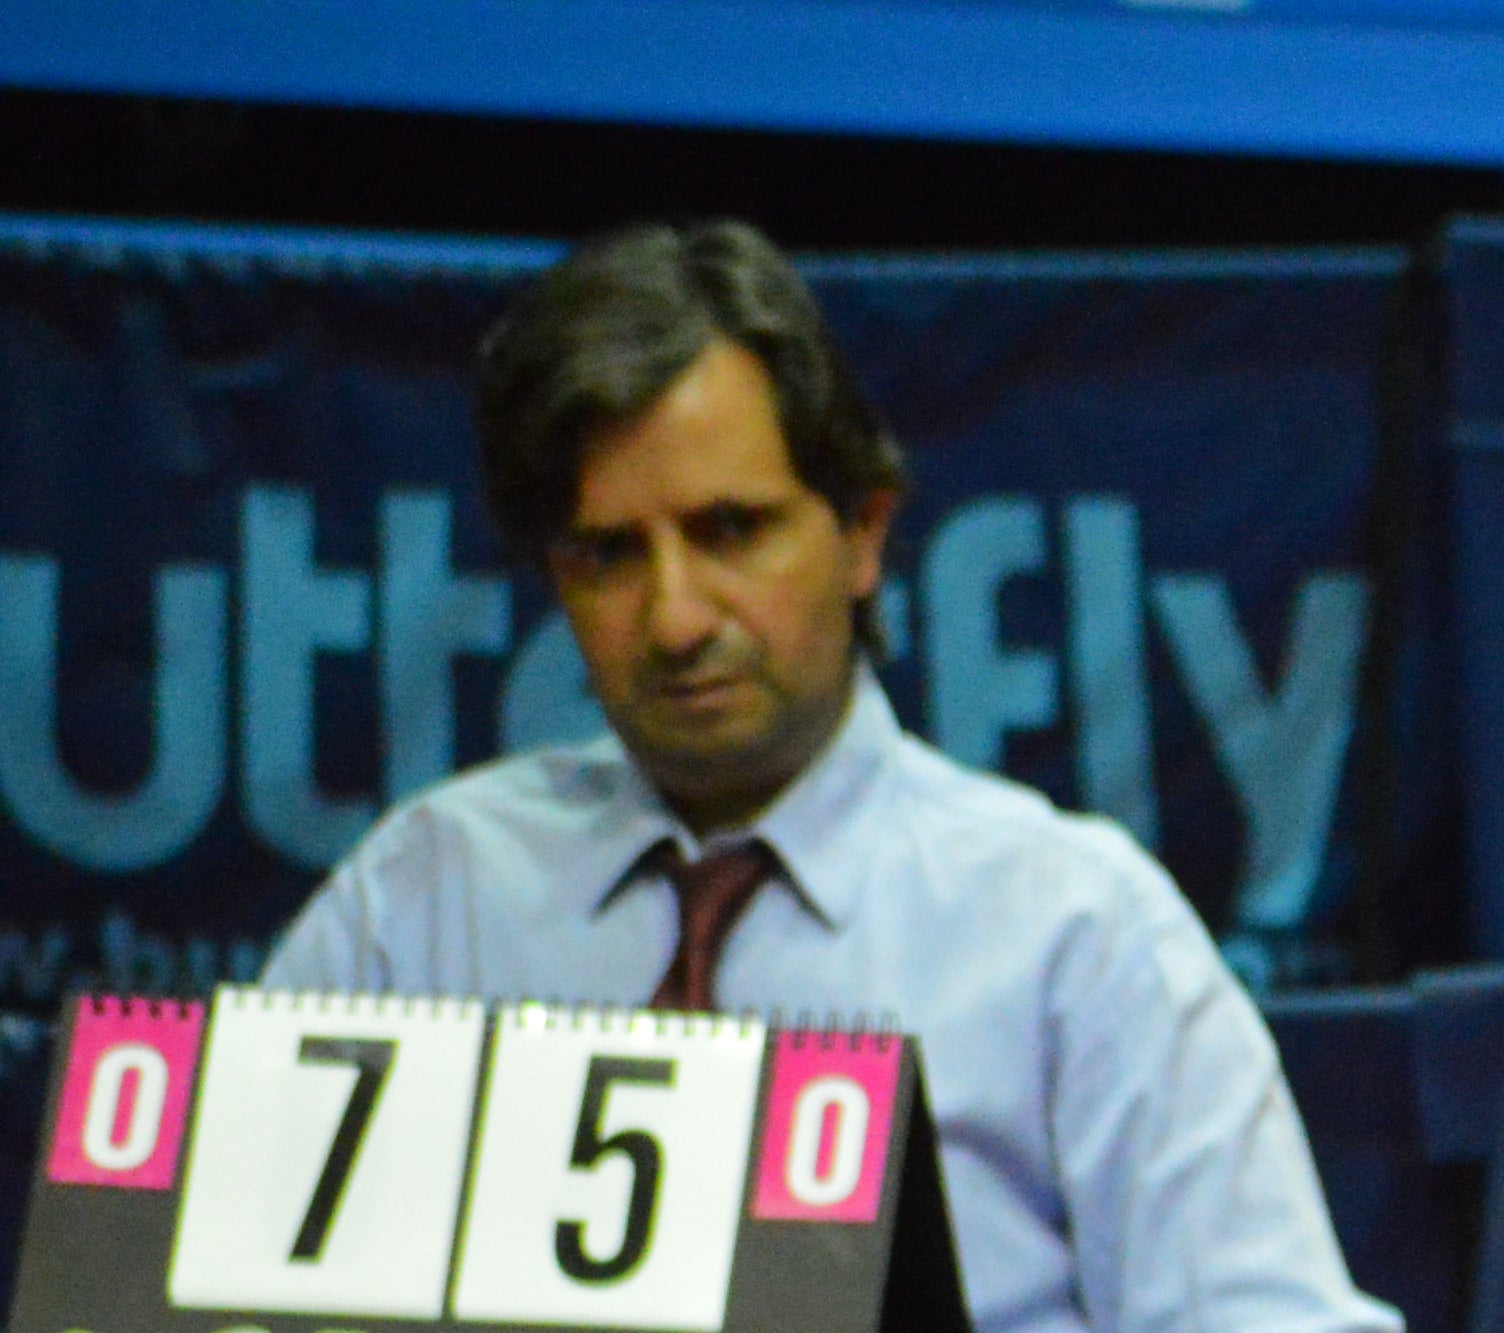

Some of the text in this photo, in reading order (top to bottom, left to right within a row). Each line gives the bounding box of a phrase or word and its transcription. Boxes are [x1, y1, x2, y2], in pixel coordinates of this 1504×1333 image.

[80, 1035, 872, 1288] 0 7 5 0
